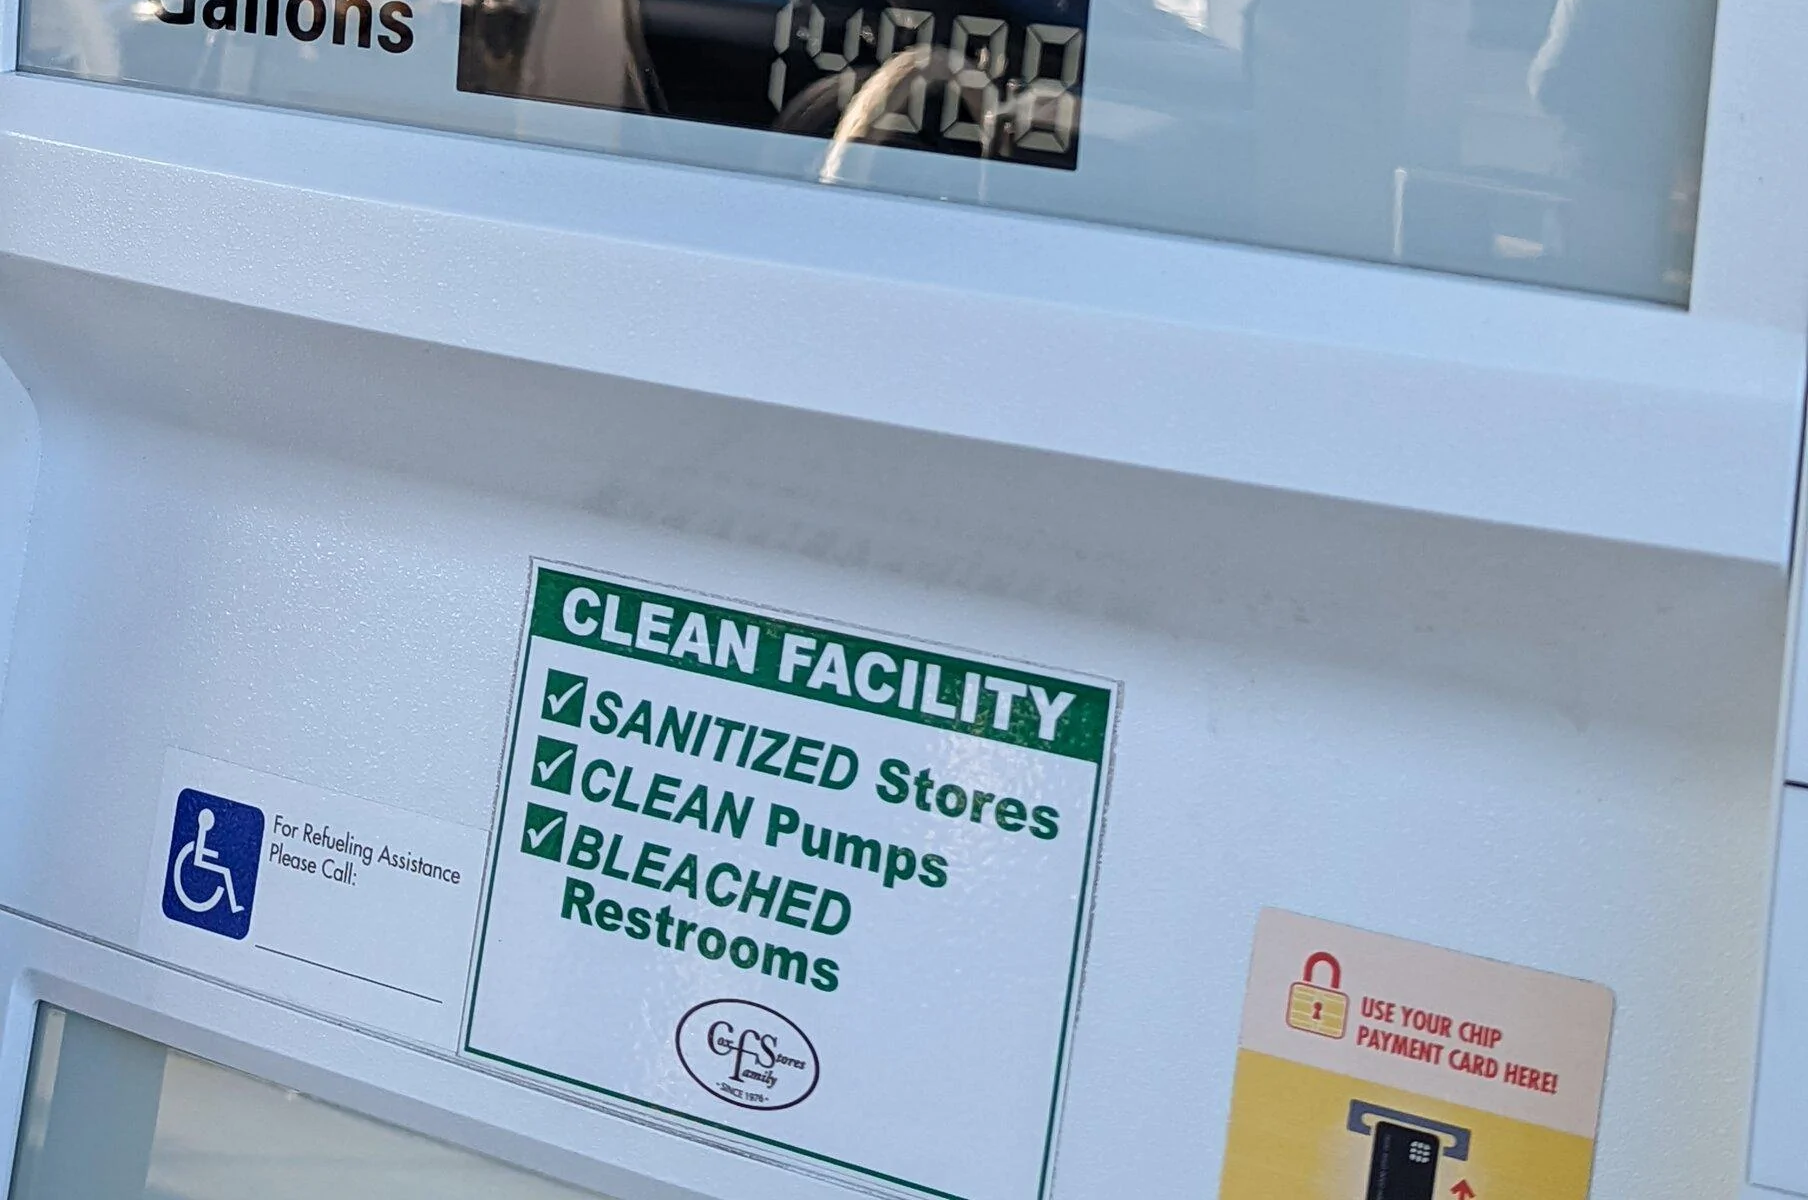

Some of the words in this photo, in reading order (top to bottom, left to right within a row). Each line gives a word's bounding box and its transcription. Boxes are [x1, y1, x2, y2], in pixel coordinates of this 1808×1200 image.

[561, 586, 759, 675] CLEAN
[778, 633, 1077, 742] FACILITY
[589, 690, 859, 793] SANITIZED
[876, 757, 1061, 842] Stores
[268, 843, 317, 873] Please
[321, 858, 357, 887] Call:
[274, 814, 299, 840] For
[303, 823, 374, 866] Refueling
[378, 845, 461, 885] Assistance
[580, 759, 754, 840] CLEAN
[765, 802, 949, 889] Pumps
[560, 876, 840, 994] Restrooms
[567, 825, 852, 937] BLEACHED
[1356, 1025, 1443, 1066] PAYMENT
[1447, 1048, 1498, 1080] CARD
[1503, 1062, 1558, 1095] HERE!
[1360, 996, 1396, 1022] USE
[1401, 1005, 1452, 1038] YOUR
[1458, 1021, 1502, 1049] CHIP
